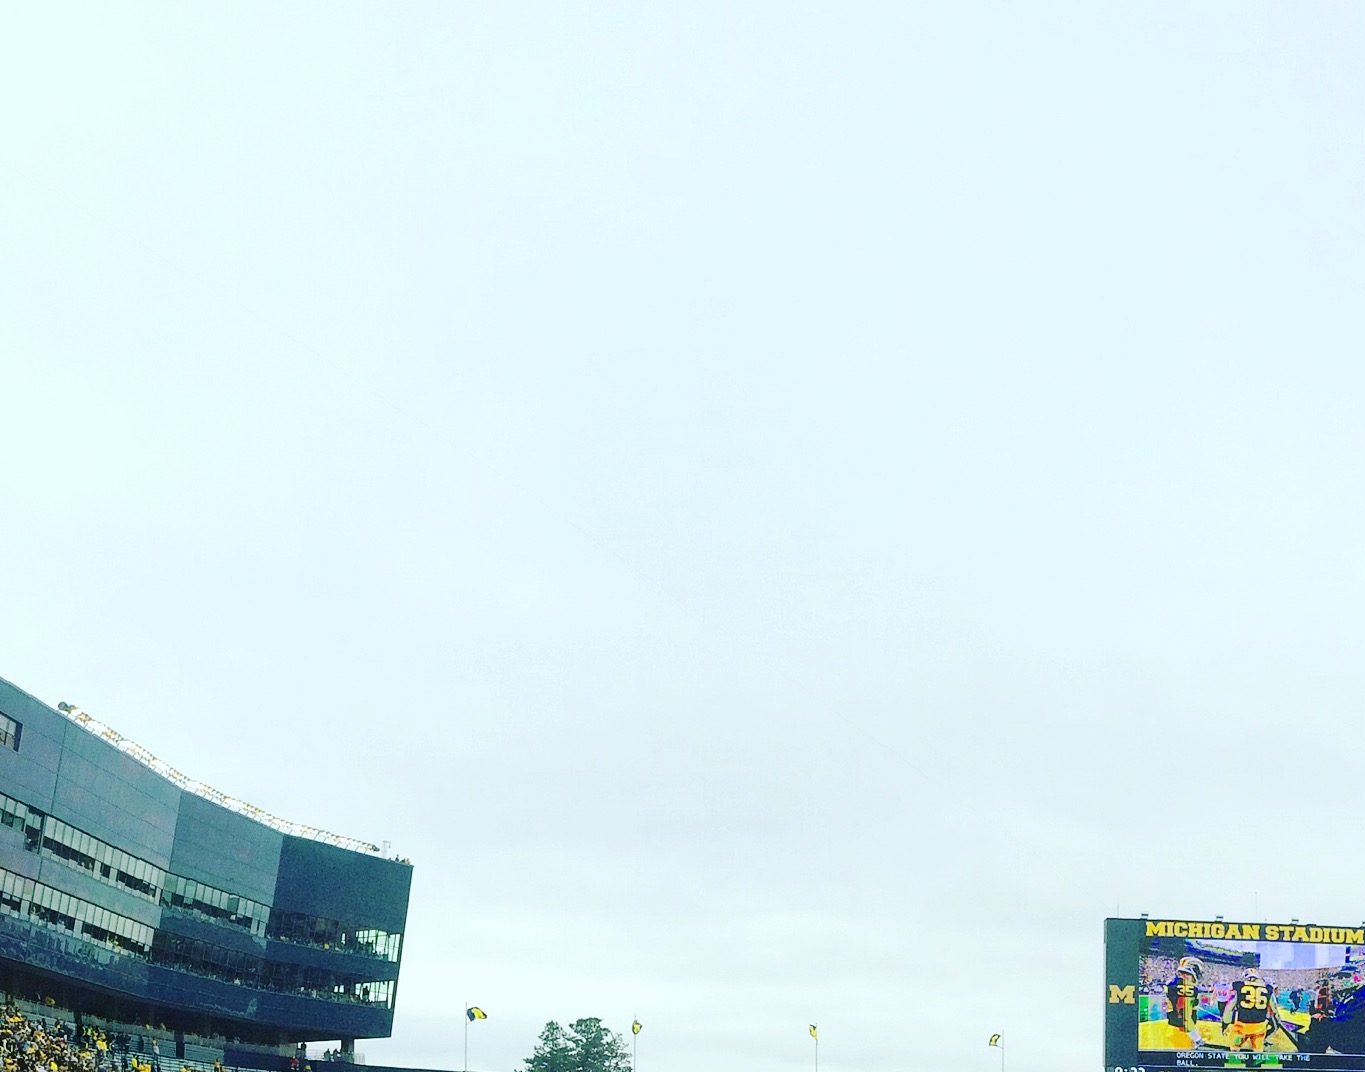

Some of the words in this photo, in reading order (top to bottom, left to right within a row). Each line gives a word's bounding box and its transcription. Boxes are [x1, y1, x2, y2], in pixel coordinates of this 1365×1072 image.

[1145, 921, 1260, 940] MICHIGAN
[1264, 926, 1365, 944] STADIUM
[1109, 984, 1136, 1004] M
[1240, 985, 1269, 1010] 36
